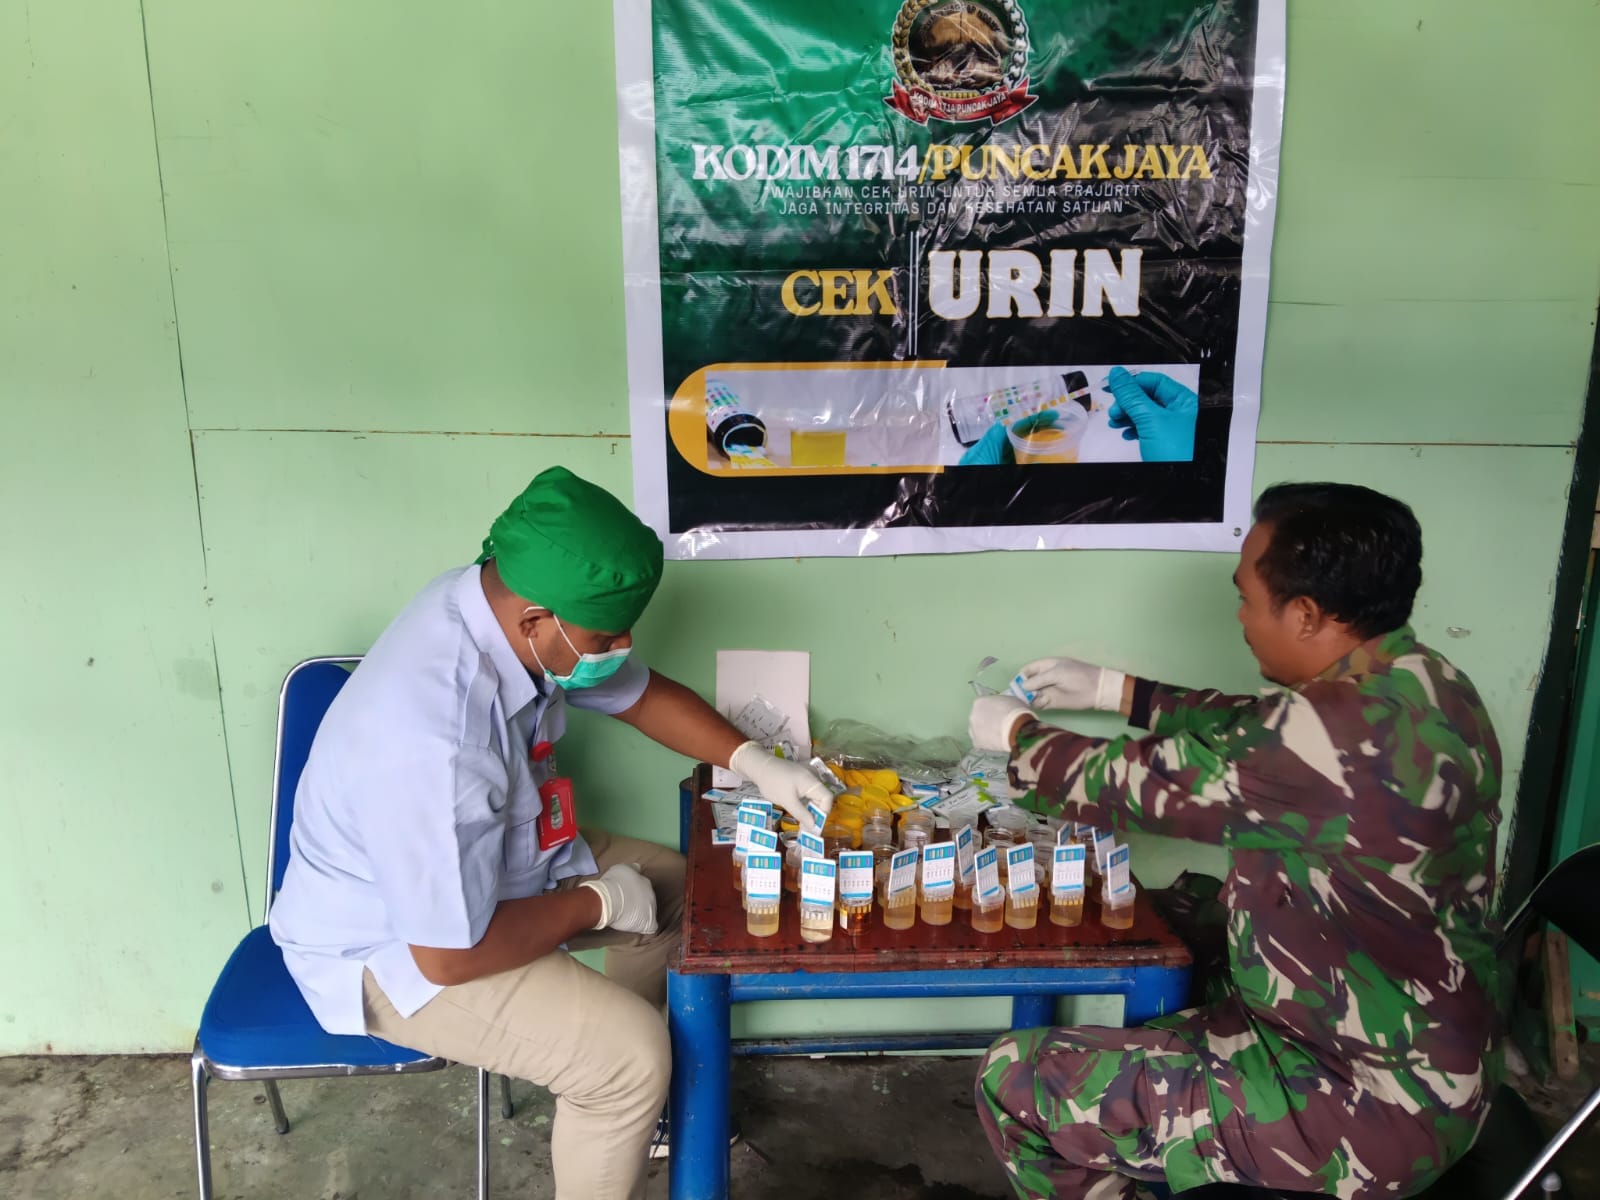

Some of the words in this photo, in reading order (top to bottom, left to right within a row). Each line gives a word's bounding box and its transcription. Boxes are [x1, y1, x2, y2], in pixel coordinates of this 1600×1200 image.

[691, 144, 841, 180] KODIM
[1113, 144, 1214, 180] JAYA
[779, 202, 818, 215] JAGA
[825, 202, 920, 215] INTEGRITAS
[927, 202, 957, 214] DAN
[965, 201, 1056, 214] KESEHATAN
[861, 185, 891, 198] CEK
[898, 185, 935, 198] URIN
[943, 185, 995, 198] UNTUK
[1003, 185, 1057, 197] SEMUA
[782, 269, 898, 315] CEK
[928, 249, 1143, 320] URIN
